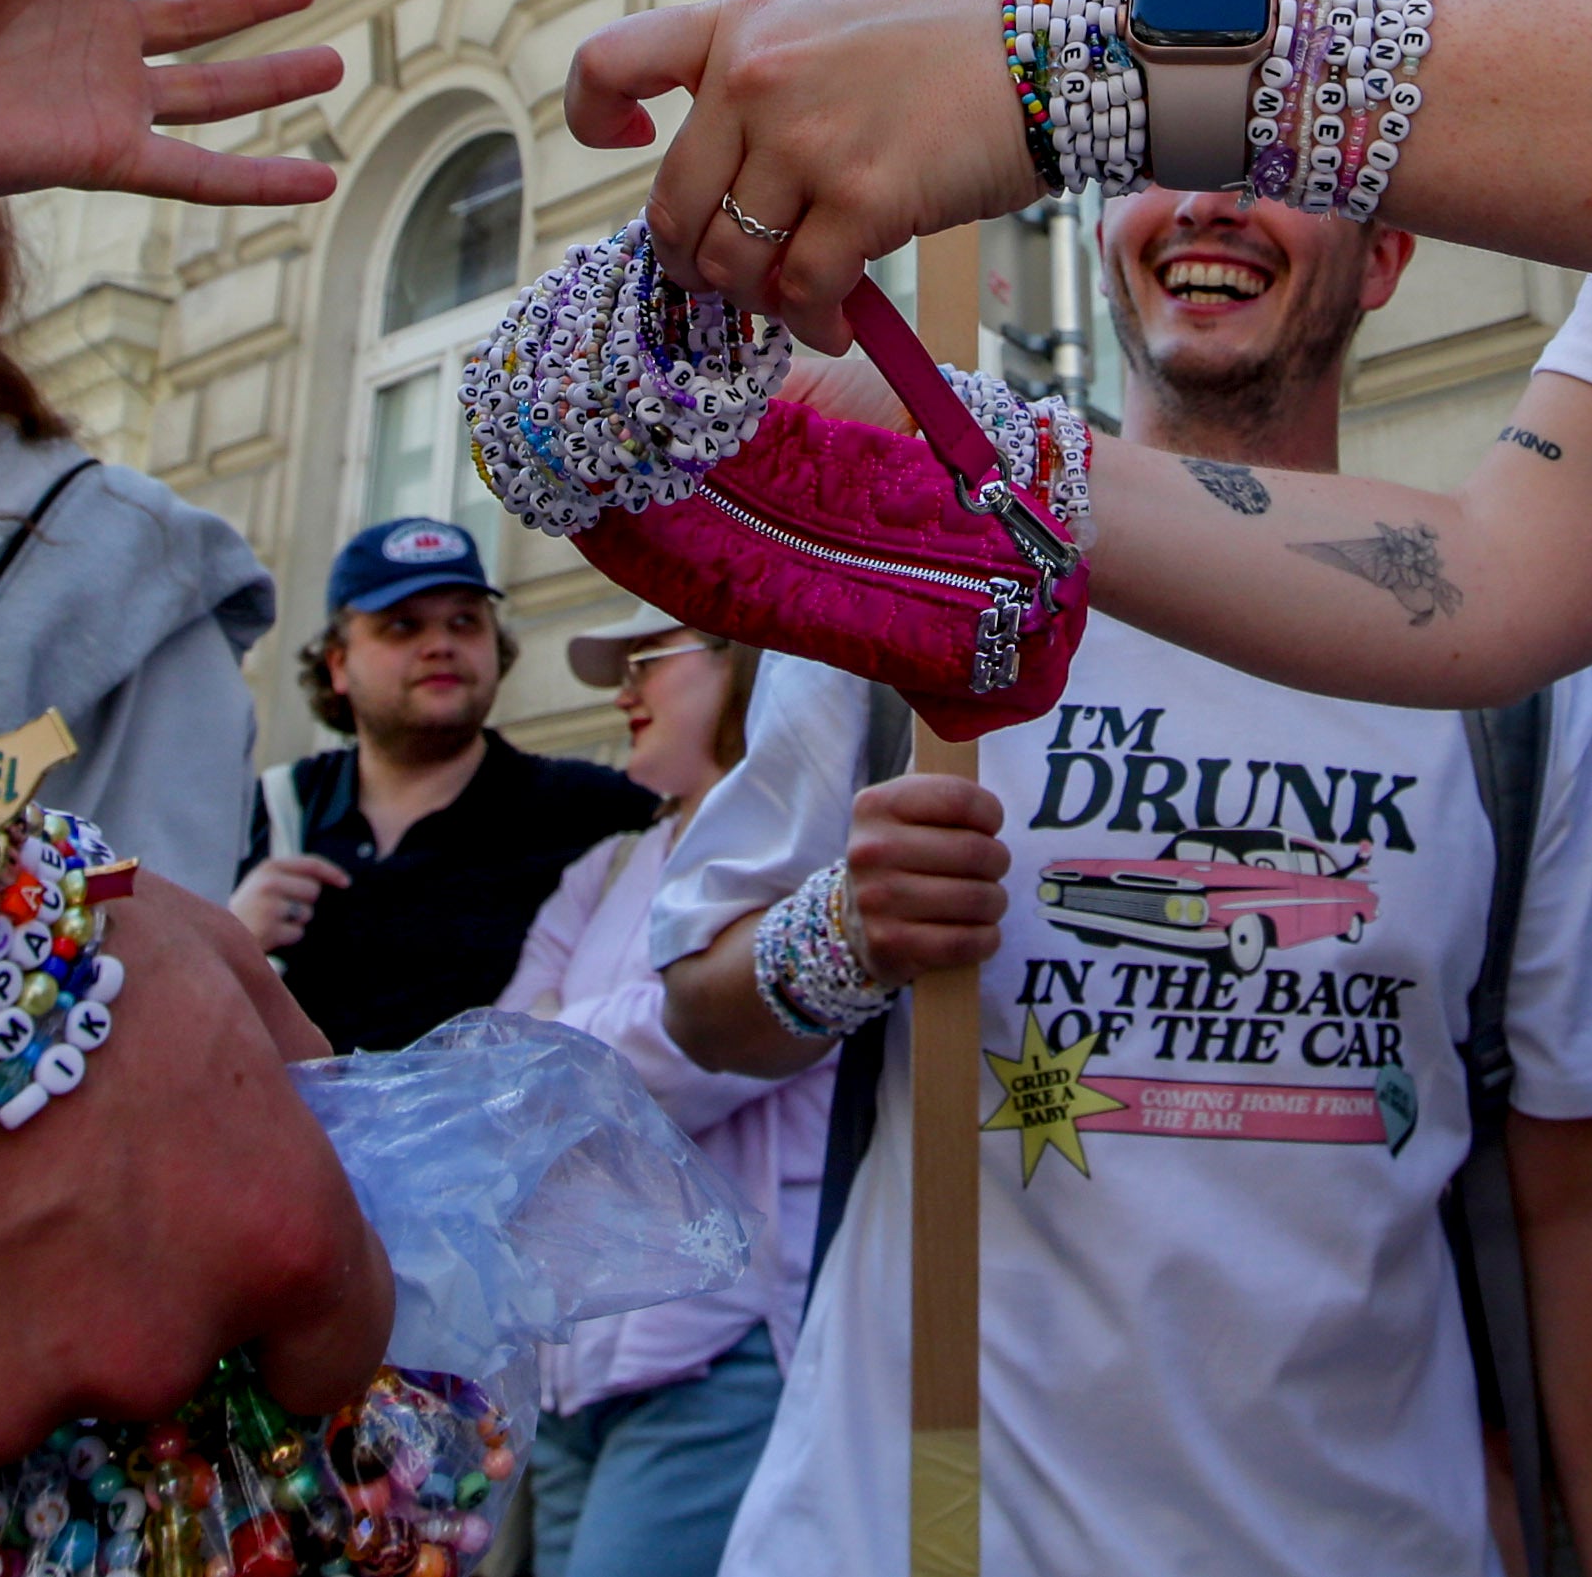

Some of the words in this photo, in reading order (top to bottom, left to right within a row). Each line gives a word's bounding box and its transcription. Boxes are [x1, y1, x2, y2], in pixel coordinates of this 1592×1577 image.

[1512, 429, 1562, 461] KIND
[1047, 704, 1166, 752] I'M
[1028, 752, 1417, 853] DRUNK
[1016, 960, 1095, 1006] IN
[1111, 963, 1242, 1013] THE
[1256, 970, 1416, 1022] BACK
[1048, 1010, 1135, 1056] OF
[1150, 1014, 1285, 1065] THE
[1302, 1021, 1405, 1068] CAR
[1012, 1068, 1070, 1093] CRIED
[1012, 1089, 1056, 1112] LIKE
[1062, 1085, 1076, 1102] A
[1141, 1088, 1234, 1114] COMING
[1241, 1092, 1309, 1116] HOME
[1315, 1094, 1374, 1118] FROM
[1022, 1105, 1069, 1129] BABY
[1142, 1110, 1188, 1132] THE
[1193, 1112, 1244, 1134] BAR
